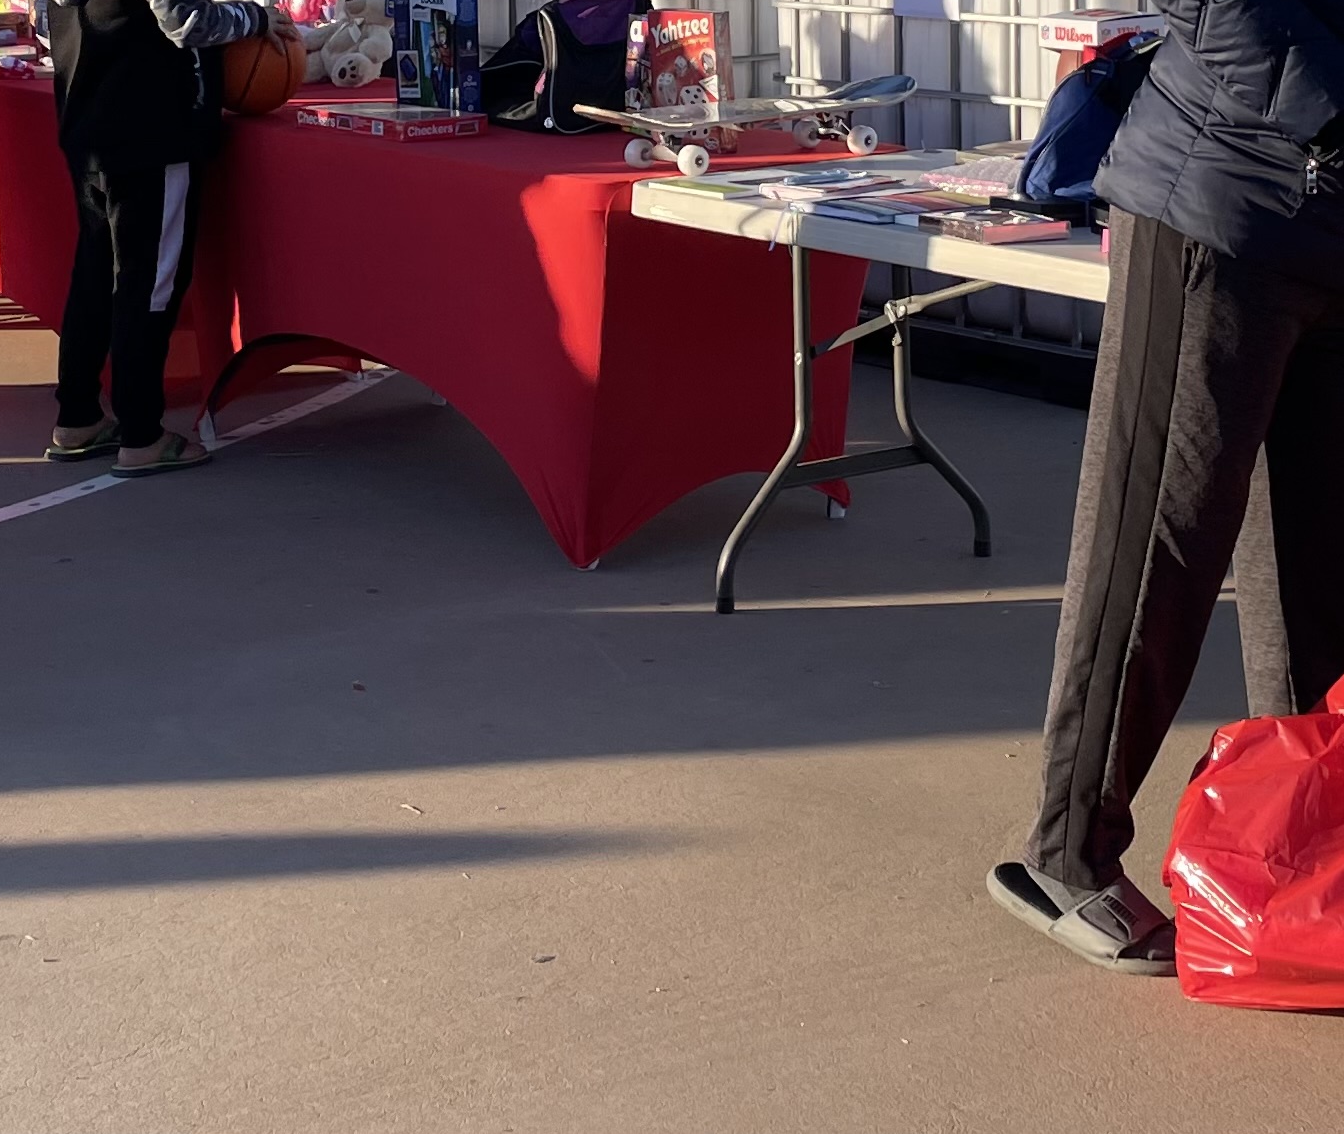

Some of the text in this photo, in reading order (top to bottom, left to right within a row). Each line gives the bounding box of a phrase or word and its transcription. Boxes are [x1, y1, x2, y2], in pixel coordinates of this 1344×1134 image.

[650, 18, 709, 48] Yahtzee
[1054, 26, 1093, 43] Wilson
[297, 111, 336, 128] Checkers
[407, 124, 454, 137] Checkers
